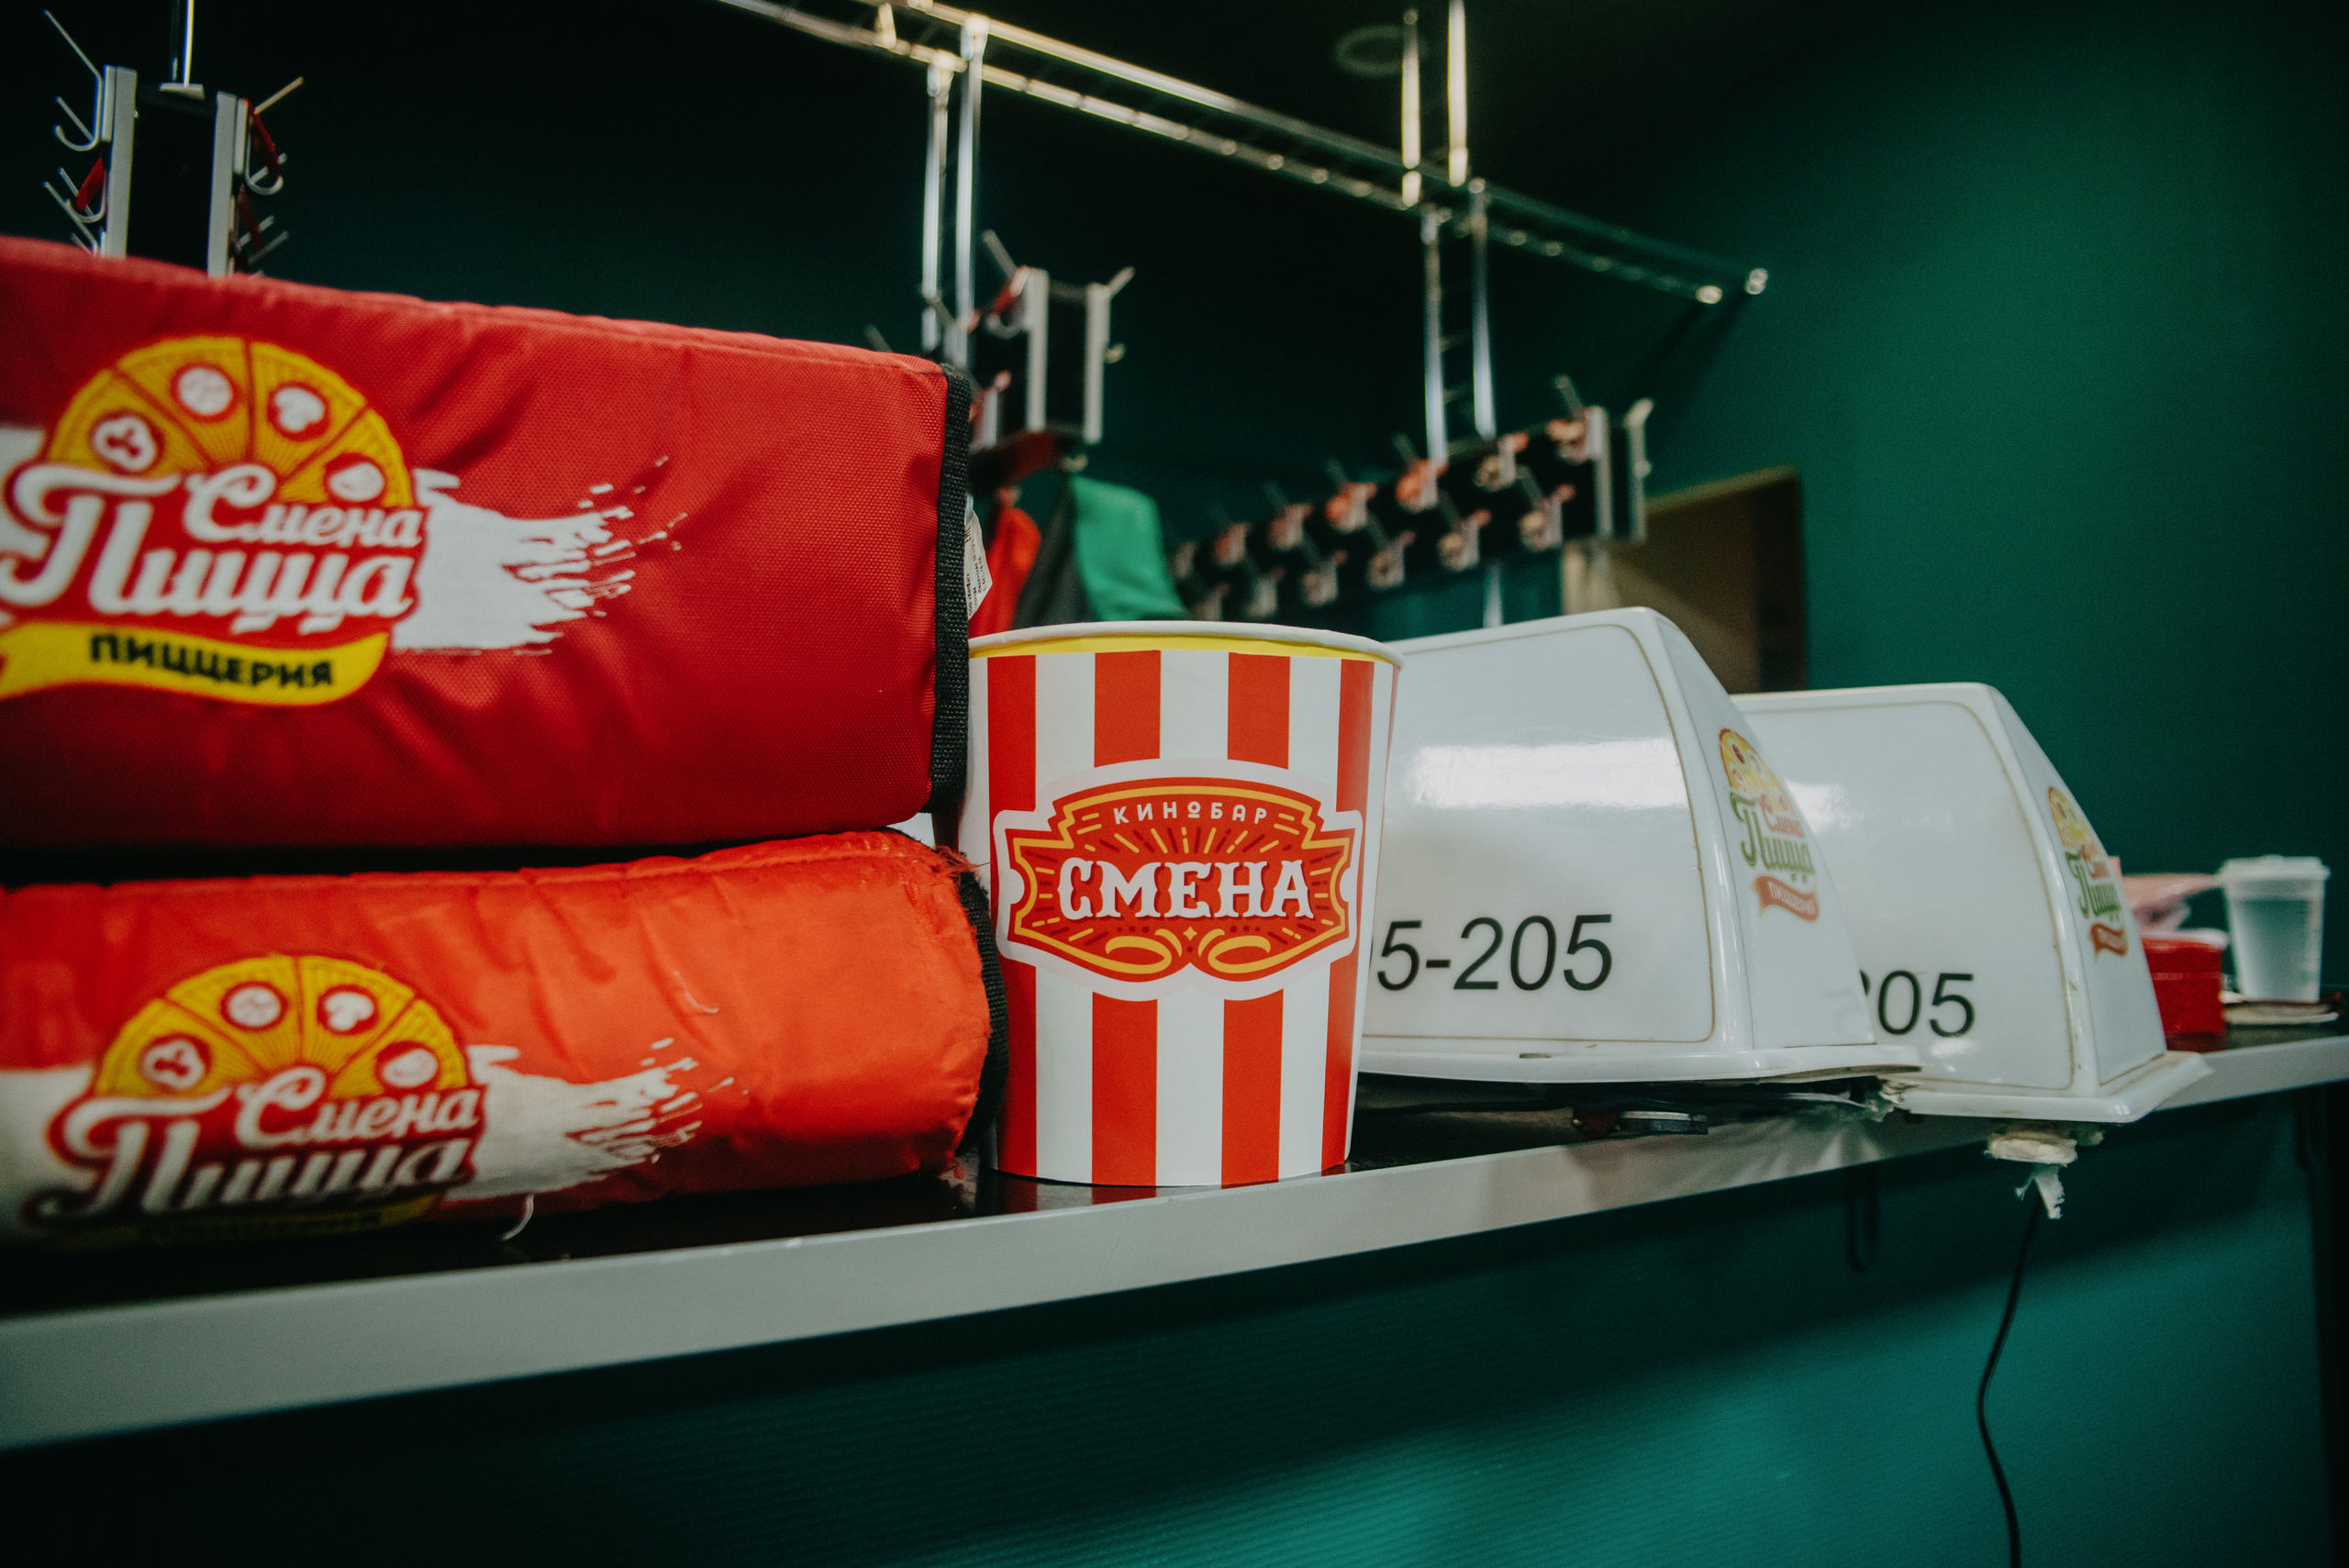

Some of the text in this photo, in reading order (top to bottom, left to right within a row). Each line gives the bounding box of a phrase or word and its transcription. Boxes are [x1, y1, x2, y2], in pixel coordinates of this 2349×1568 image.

[185, 463, 422, 547] Смена
[0, 464, 416, 635] Пицца
[89, 632, 335, 690] ПИЦЦЕРИЯ
[1113, 800, 1268, 825] КИНОБАР
[1730, 792, 1816, 884] Пицца
[1057, 857, 1314, 920] СМЕНА
[1369, 914, 1613, 991] 5-205
[1860, 970, 1976, 1038] 05
[233, 1066, 482, 1149] Смена
